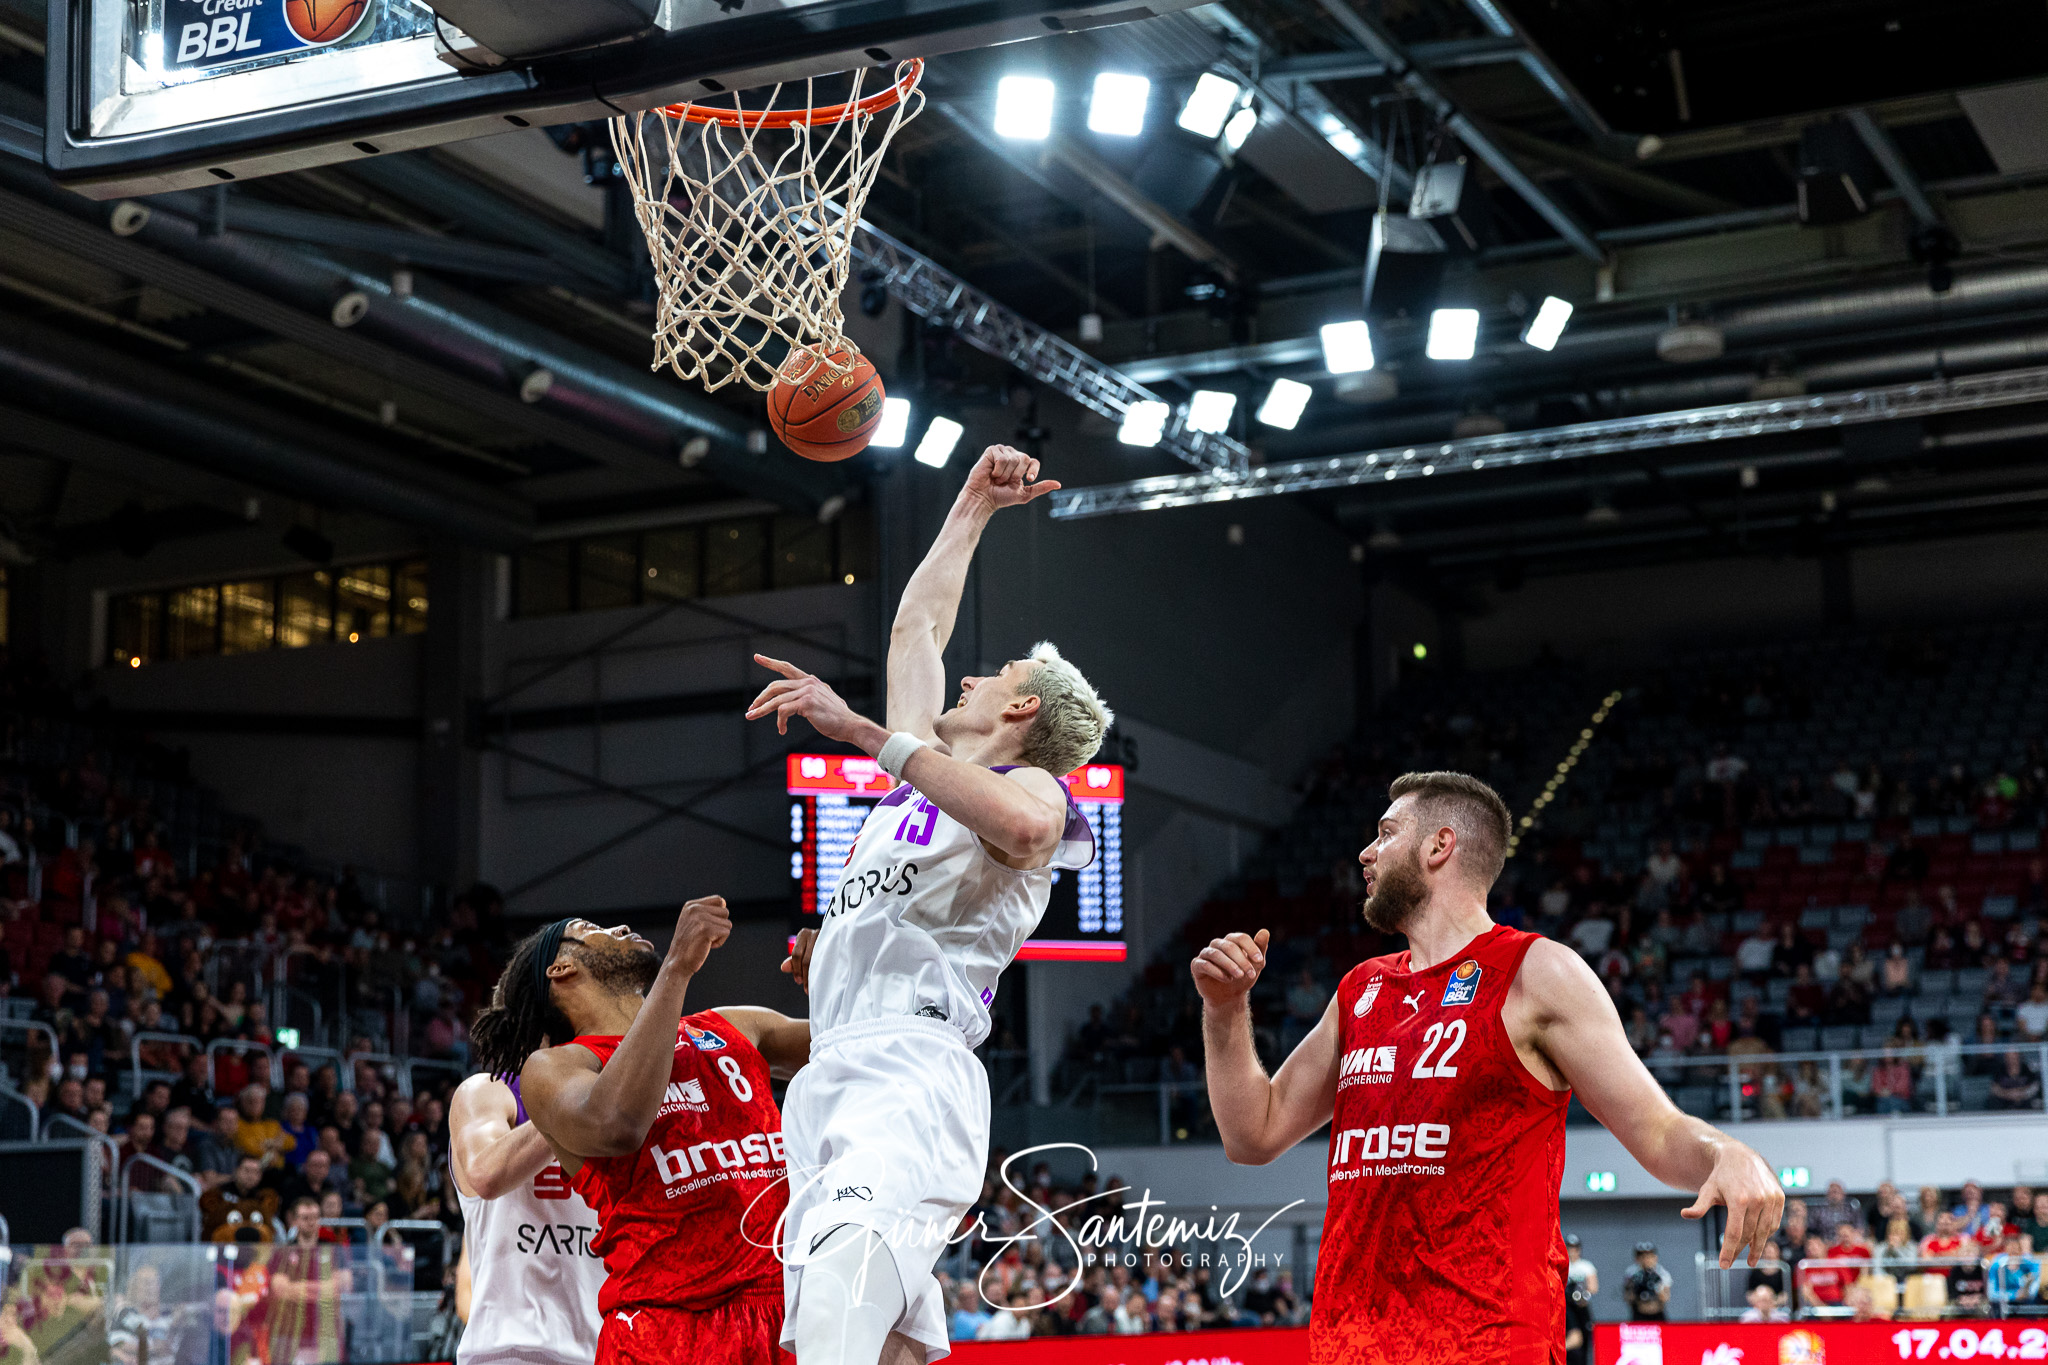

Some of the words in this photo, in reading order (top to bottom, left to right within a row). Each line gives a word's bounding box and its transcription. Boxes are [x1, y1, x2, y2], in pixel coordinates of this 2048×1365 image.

[176, 11, 261, 63] BBL
[1445, 991, 1469, 1002] BBL
[1412, 1018, 1467, 1079] 22
[717, 1056, 753, 1103] 8
[665, 1172, 728, 1199] Excellence
[1891, 1328, 2047, 1360] 17.04.2
